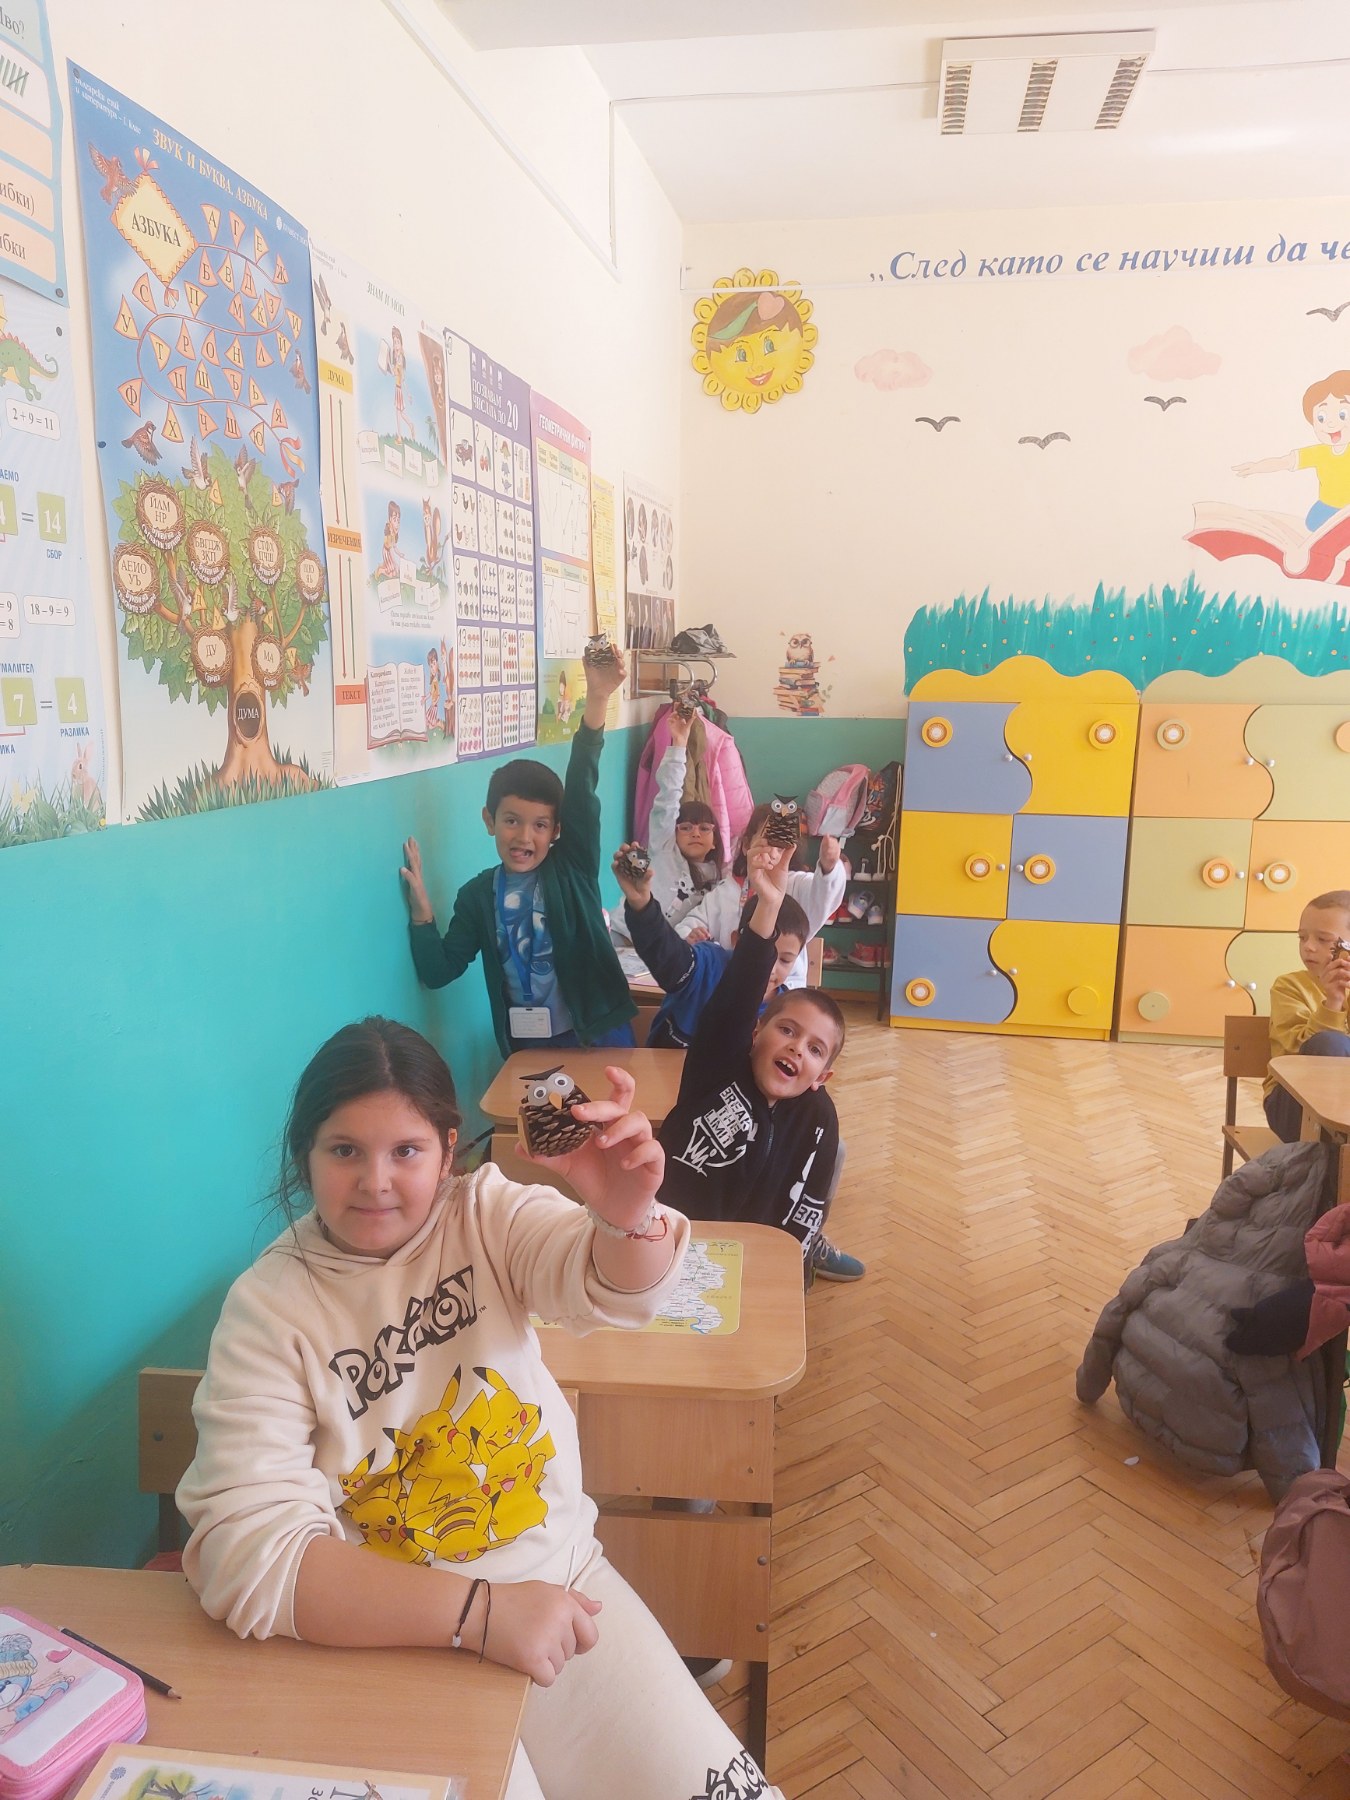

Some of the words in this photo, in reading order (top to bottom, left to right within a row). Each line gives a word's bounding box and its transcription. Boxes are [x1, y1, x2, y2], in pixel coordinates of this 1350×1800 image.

[152, 128, 183, 162] ЗВУК
[186, 150, 195, 169] И
[236, 185, 268, 221] АЗБУКА
[208, 211, 217, 228] А
[233, 220, 240, 236] Г
[131, 211, 182, 247] АЗБУКА
[256, 236, 262, 252] Е
[978, 254, 1063, 277] като
[1076, 250, 1110, 272] се
[1118, 245, 1255, 271] научиш
[1267, 233, 1308, 263] да
[202, 263, 210, 281] Б
[225, 266, 232, 283] В
[276, 264, 287, 283] Ж
[245, 273, 252, 293] Д
[139, 285, 150, 303] С
[189, 287, 199, 307] П
[367, 281, 384, 303] ЗНАМ
[384, 292, 390, 306] И
[233, 300, 242, 319] М
[257, 306, 265, 323] К
[121, 313, 131, 333] У
[291, 315, 299, 332] И
[155, 341, 163, 360] Т
[183, 336, 189, 353] Р
[206, 341, 215, 359] О
[279, 334, 287, 353] Й
[233, 346, 241, 363] Н
[258, 346, 266, 362] Л
[174, 372, 184, 391] Ц
[197, 370, 208, 388] Ш
[230, 374, 240, 391] Ъ
[327, 369, 345, 386] ДУМА
[125, 385, 138, 406] Ф
[252, 384, 259, 400] Ь
[200, 413, 208, 431] Ч
[275, 408, 282, 423] Я
[450, 411, 455, 431] 1
[497, 409, 506, 425] ДО
[506, 399, 519, 431] 20
[168, 420, 177, 438] Х
[253, 429, 264, 447] Ю
[150, 495, 171, 513] ЙЛМ
[452, 485, 459, 505] 5
[43, 509, 62, 534] 14
[155, 511, 167, 523] НР
[46, 549, 63, 560] СБОР
[201, 550, 216, 562] ЗКП
[121, 559, 147, 574] АЕИО
[455, 562, 461, 576] 9
[481, 564, 488, 581] 10
[128, 573, 142, 586] УЪ
[196, 595, 202, 606] Д
[459, 628, 467, 647] 13
[205, 644, 217, 657] ДУ
[263, 649, 274, 663] МА
[0, 663, 35, 674] МАЛИТЕЛ
[341, 689, 361, 700] ТЕКСТ
[13, 693, 24, 718] 7
[67, 692, 78, 715] 4
[237, 707, 260, 721] ДУМА
[459, 697, 467, 714] 17
[60, 727, 90, 738] РАЗЛИКА
[720, 1086, 752, 1131] BREAK
[704, 1110, 734, 1147] LIMIT
[718, 1106, 741, 1135] THE
